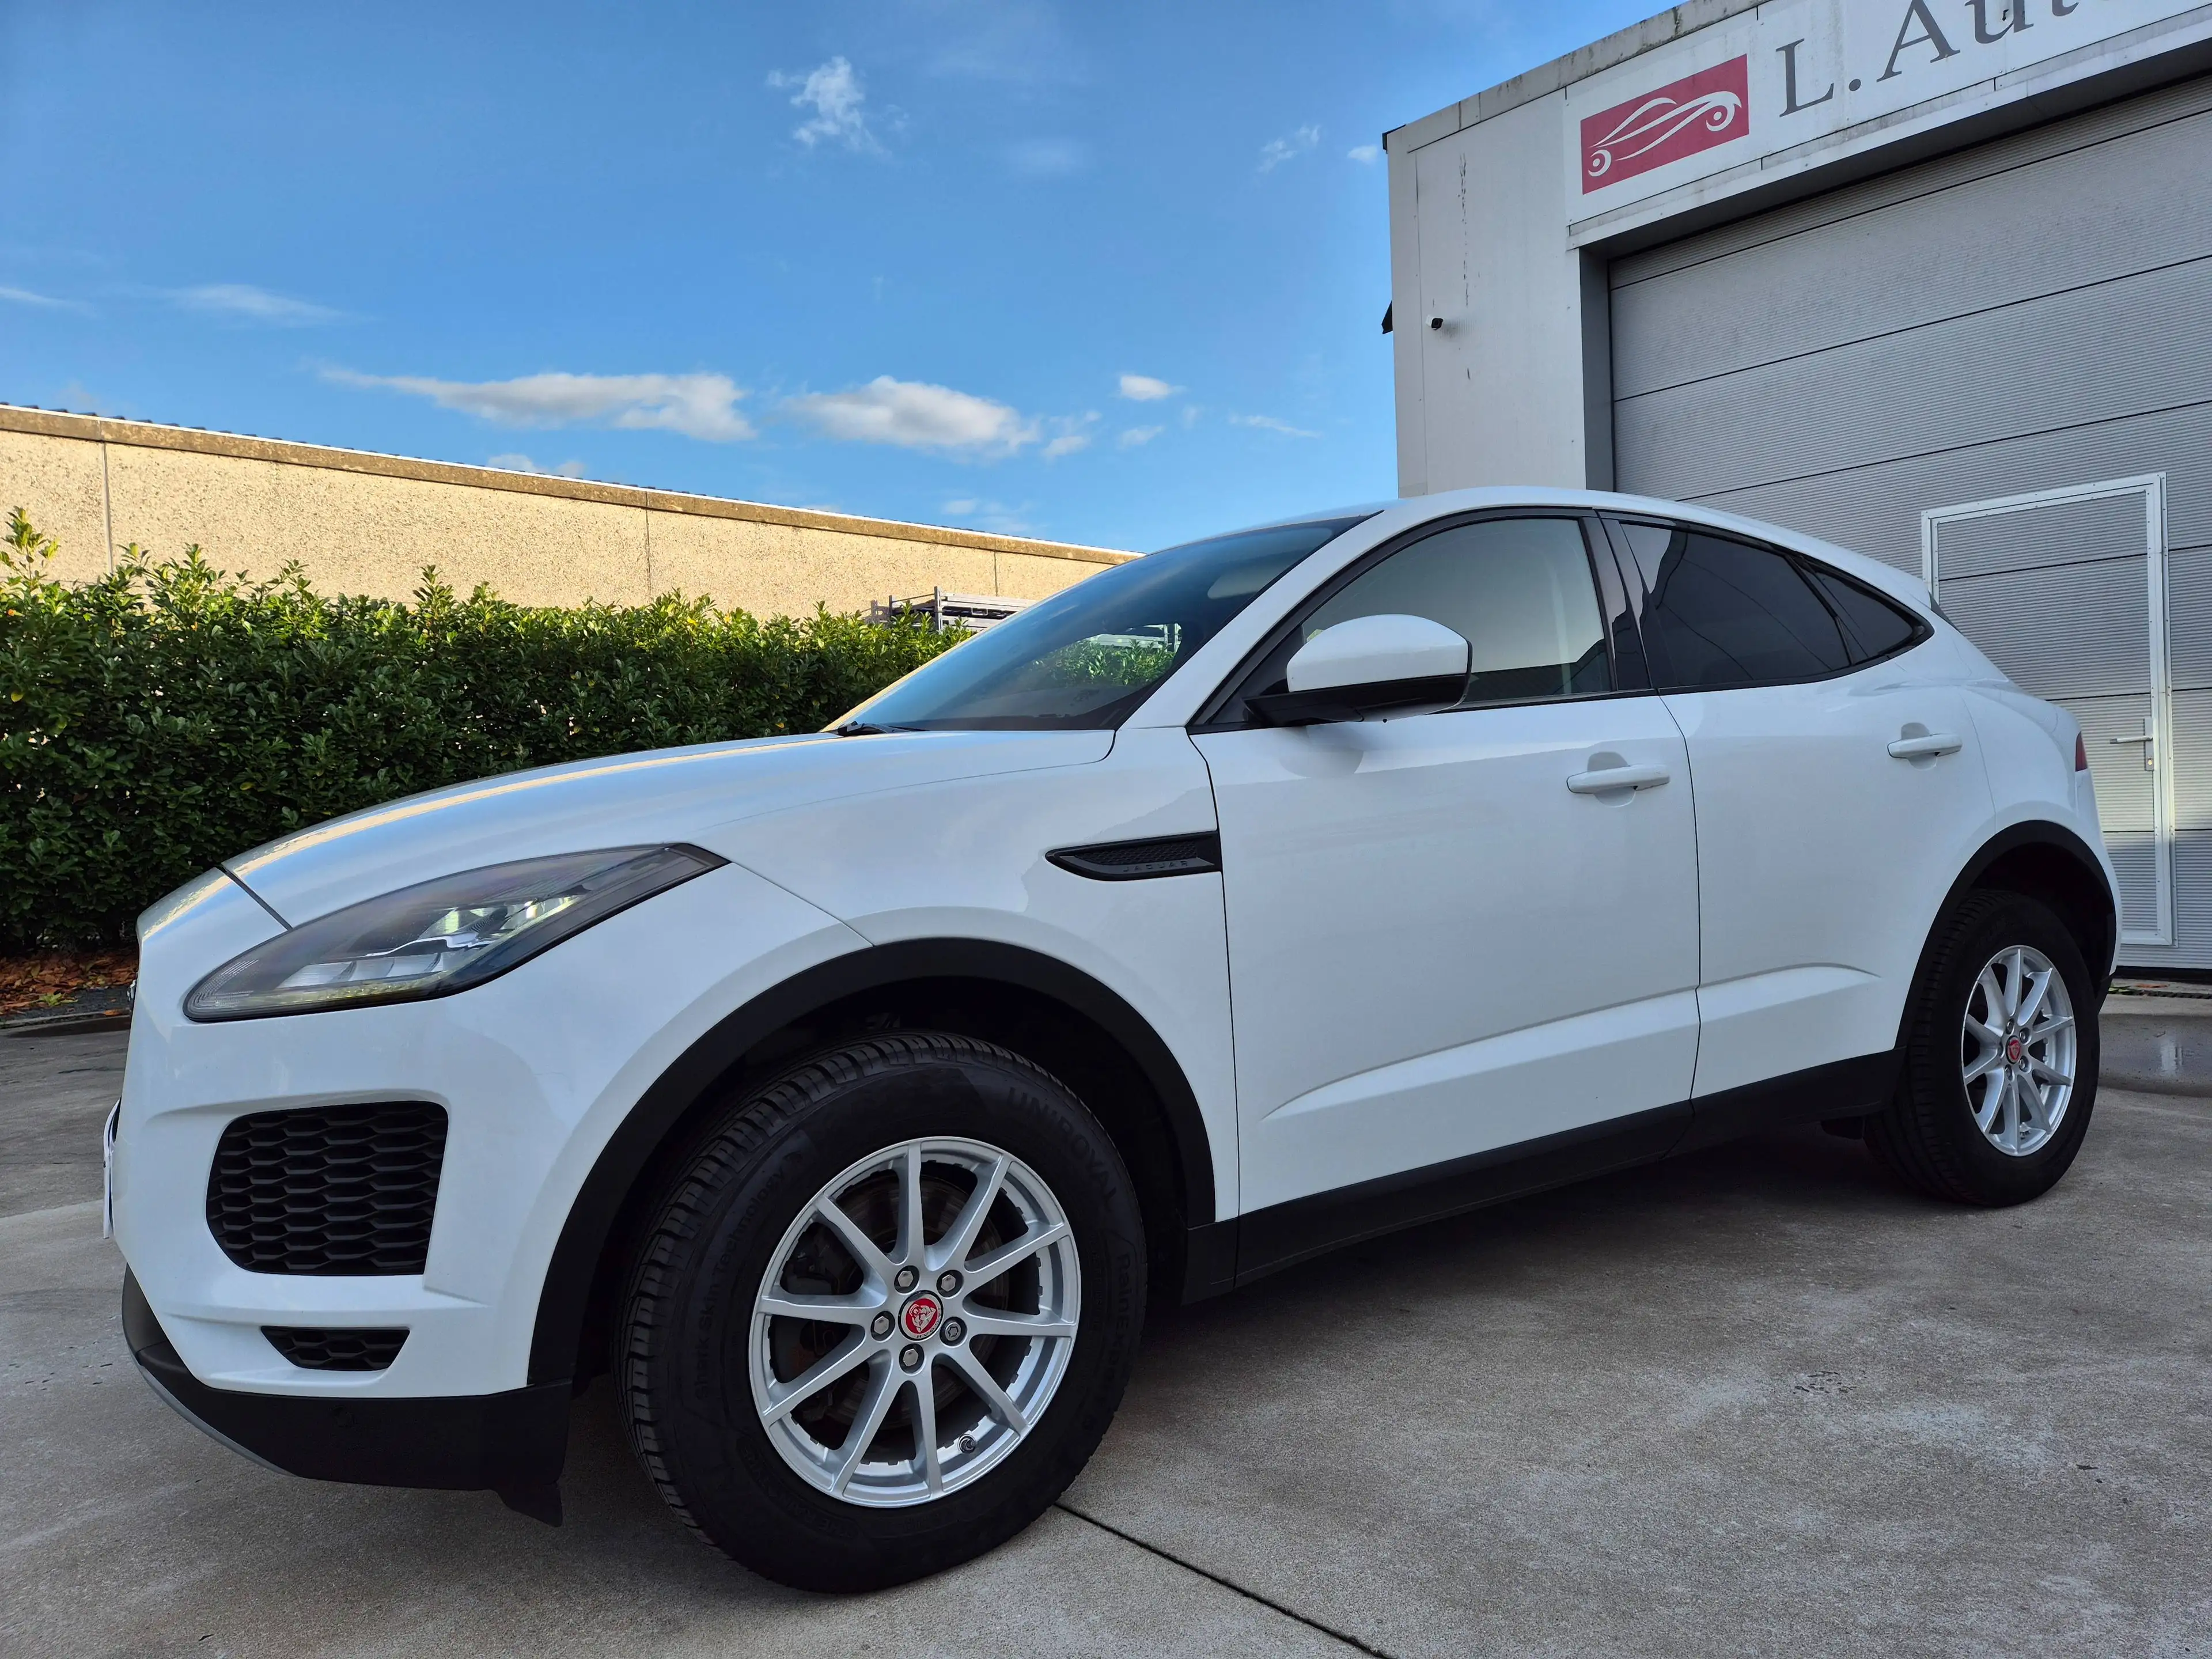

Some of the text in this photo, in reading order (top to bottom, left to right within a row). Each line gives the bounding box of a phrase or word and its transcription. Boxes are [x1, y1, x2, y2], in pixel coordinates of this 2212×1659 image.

[1123, 861, 1188, 872] JAGUAR
[1008, 1086, 1118, 1212] UNIROYAL
[694, 1165, 785, 1400] Shark Skin Technology
